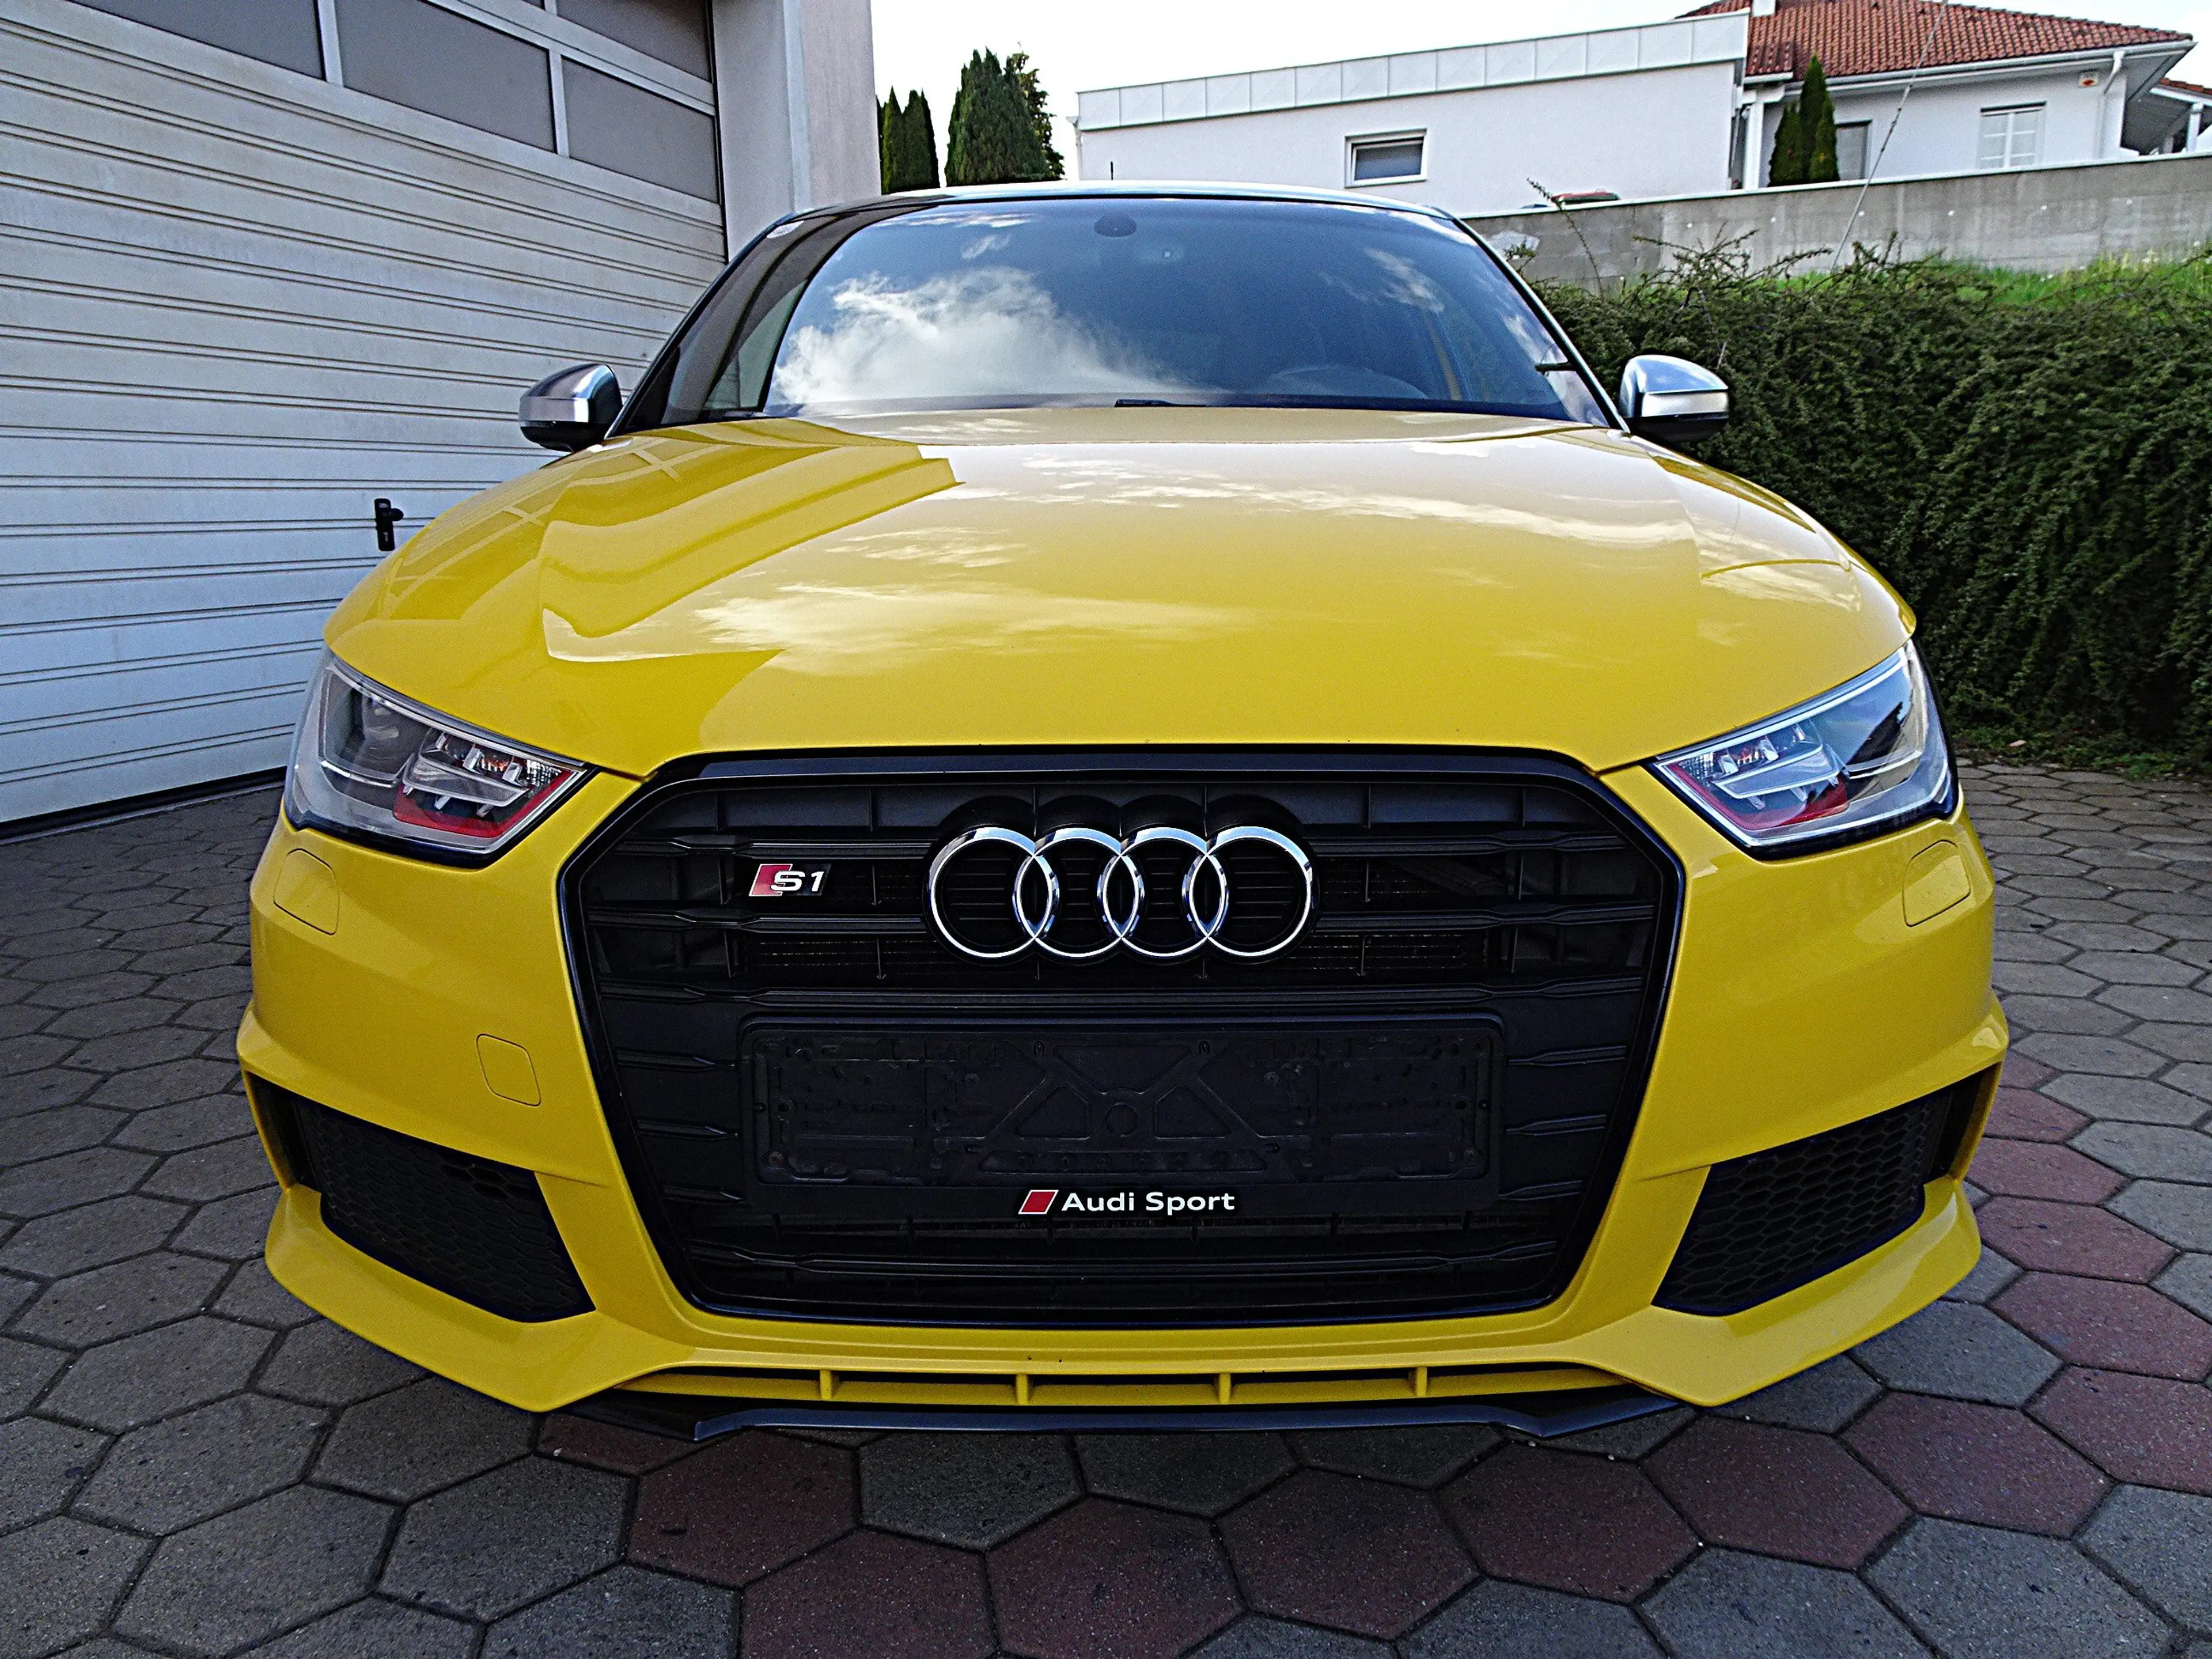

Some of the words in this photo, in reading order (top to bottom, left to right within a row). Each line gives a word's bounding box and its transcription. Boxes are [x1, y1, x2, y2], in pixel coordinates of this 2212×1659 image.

[770, 870, 824, 892] S1
[1061, 1192, 1134, 1211] Audi
[1146, 1191, 1235, 1216] Sport
